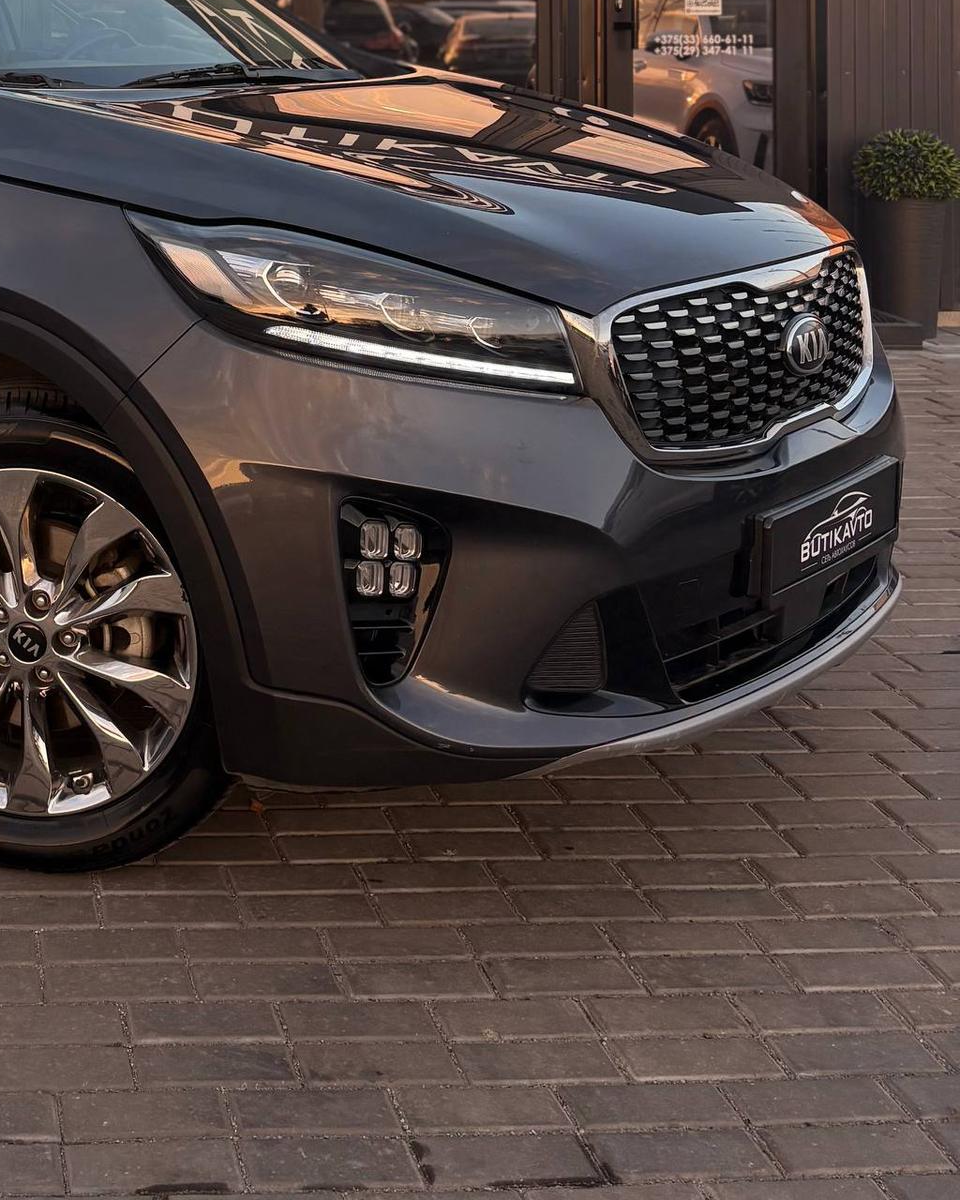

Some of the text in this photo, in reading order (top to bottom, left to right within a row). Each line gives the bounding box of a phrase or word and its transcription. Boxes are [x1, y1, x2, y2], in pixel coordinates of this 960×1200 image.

[654, 34, 700, 48] +375(33)
[654, 46, 754, 58] +375(29) 347-4111
[797, 327, 828, 364] KIA
[800, 508, 873, 563] BUTIKAVTO
[12, 627, 40, 658] KIA
